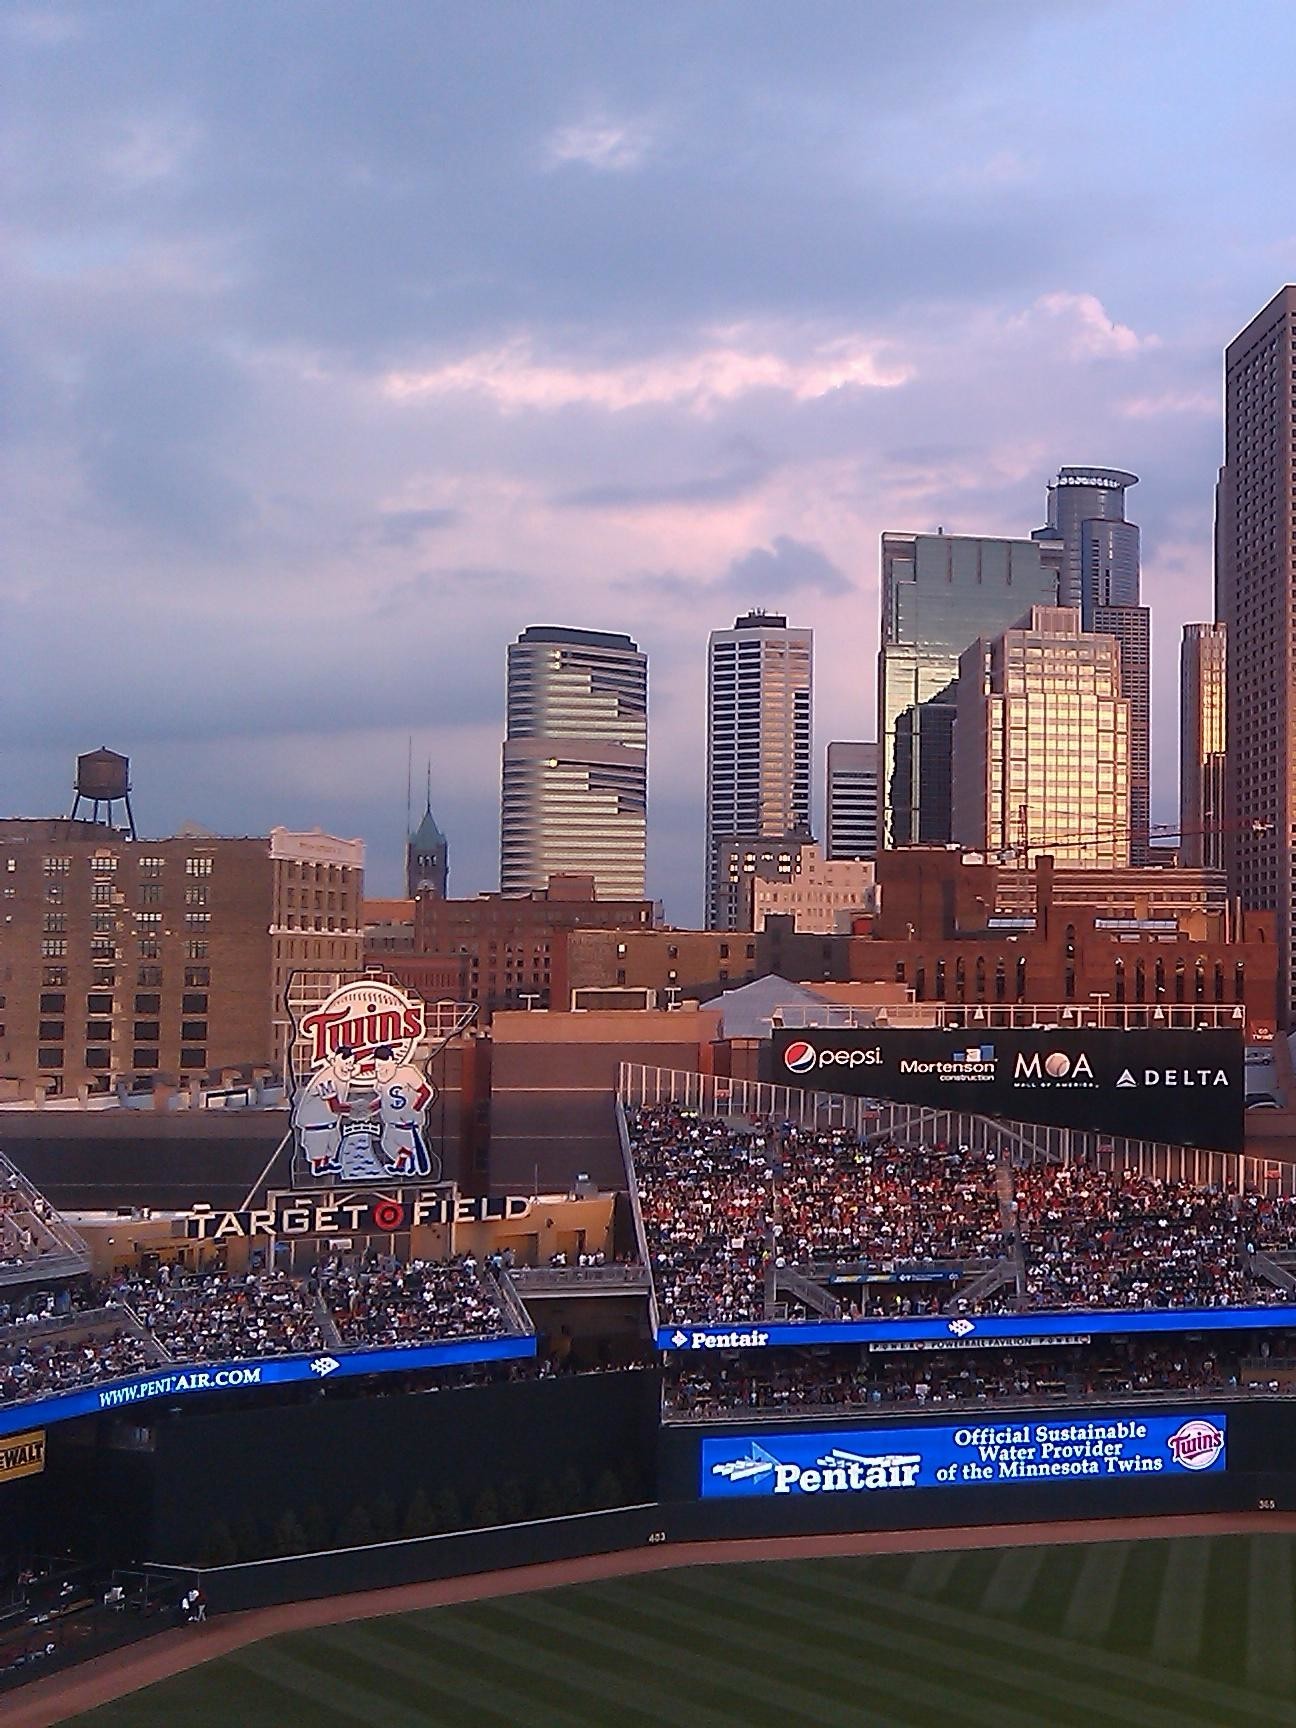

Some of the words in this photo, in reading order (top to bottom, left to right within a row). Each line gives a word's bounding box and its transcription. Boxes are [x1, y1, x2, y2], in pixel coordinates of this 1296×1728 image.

[303, 1004, 422, 1062] Twins
[818, 1046, 881, 1069] pepsi
[900, 1060, 995, 1074] Mortenson
[1014, 1052, 1094, 1079] MOA
[939, 1074, 995, 1082] construction
[1144, 1069, 1229, 1087] DELTA
[188, 1203, 368, 1239] TARGET
[413, 1195, 532, 1226] FIELD
[691, 1329, 769, 1349] Pentair
[99, 1367, 262, 1408] WWW.PENTAIR.COM
[954, 1426, 1031, 1447] Official
[1035, 1420, 1147, 1443] Sustainable
[1170, 1430, 1223, 1459] Twins
[978, 1445, 1036, 1463] Water
[1041, 1441, 1123, 1460] Provider
[773, 1459, 920, 1494] Pentair
[936, 1464, 958, 1482] of
[962, 1462, 993, 1480] the
[998, 1460, 1099, 1479] Minnesota
[1103, 1455, 1163, 1474] Twins
